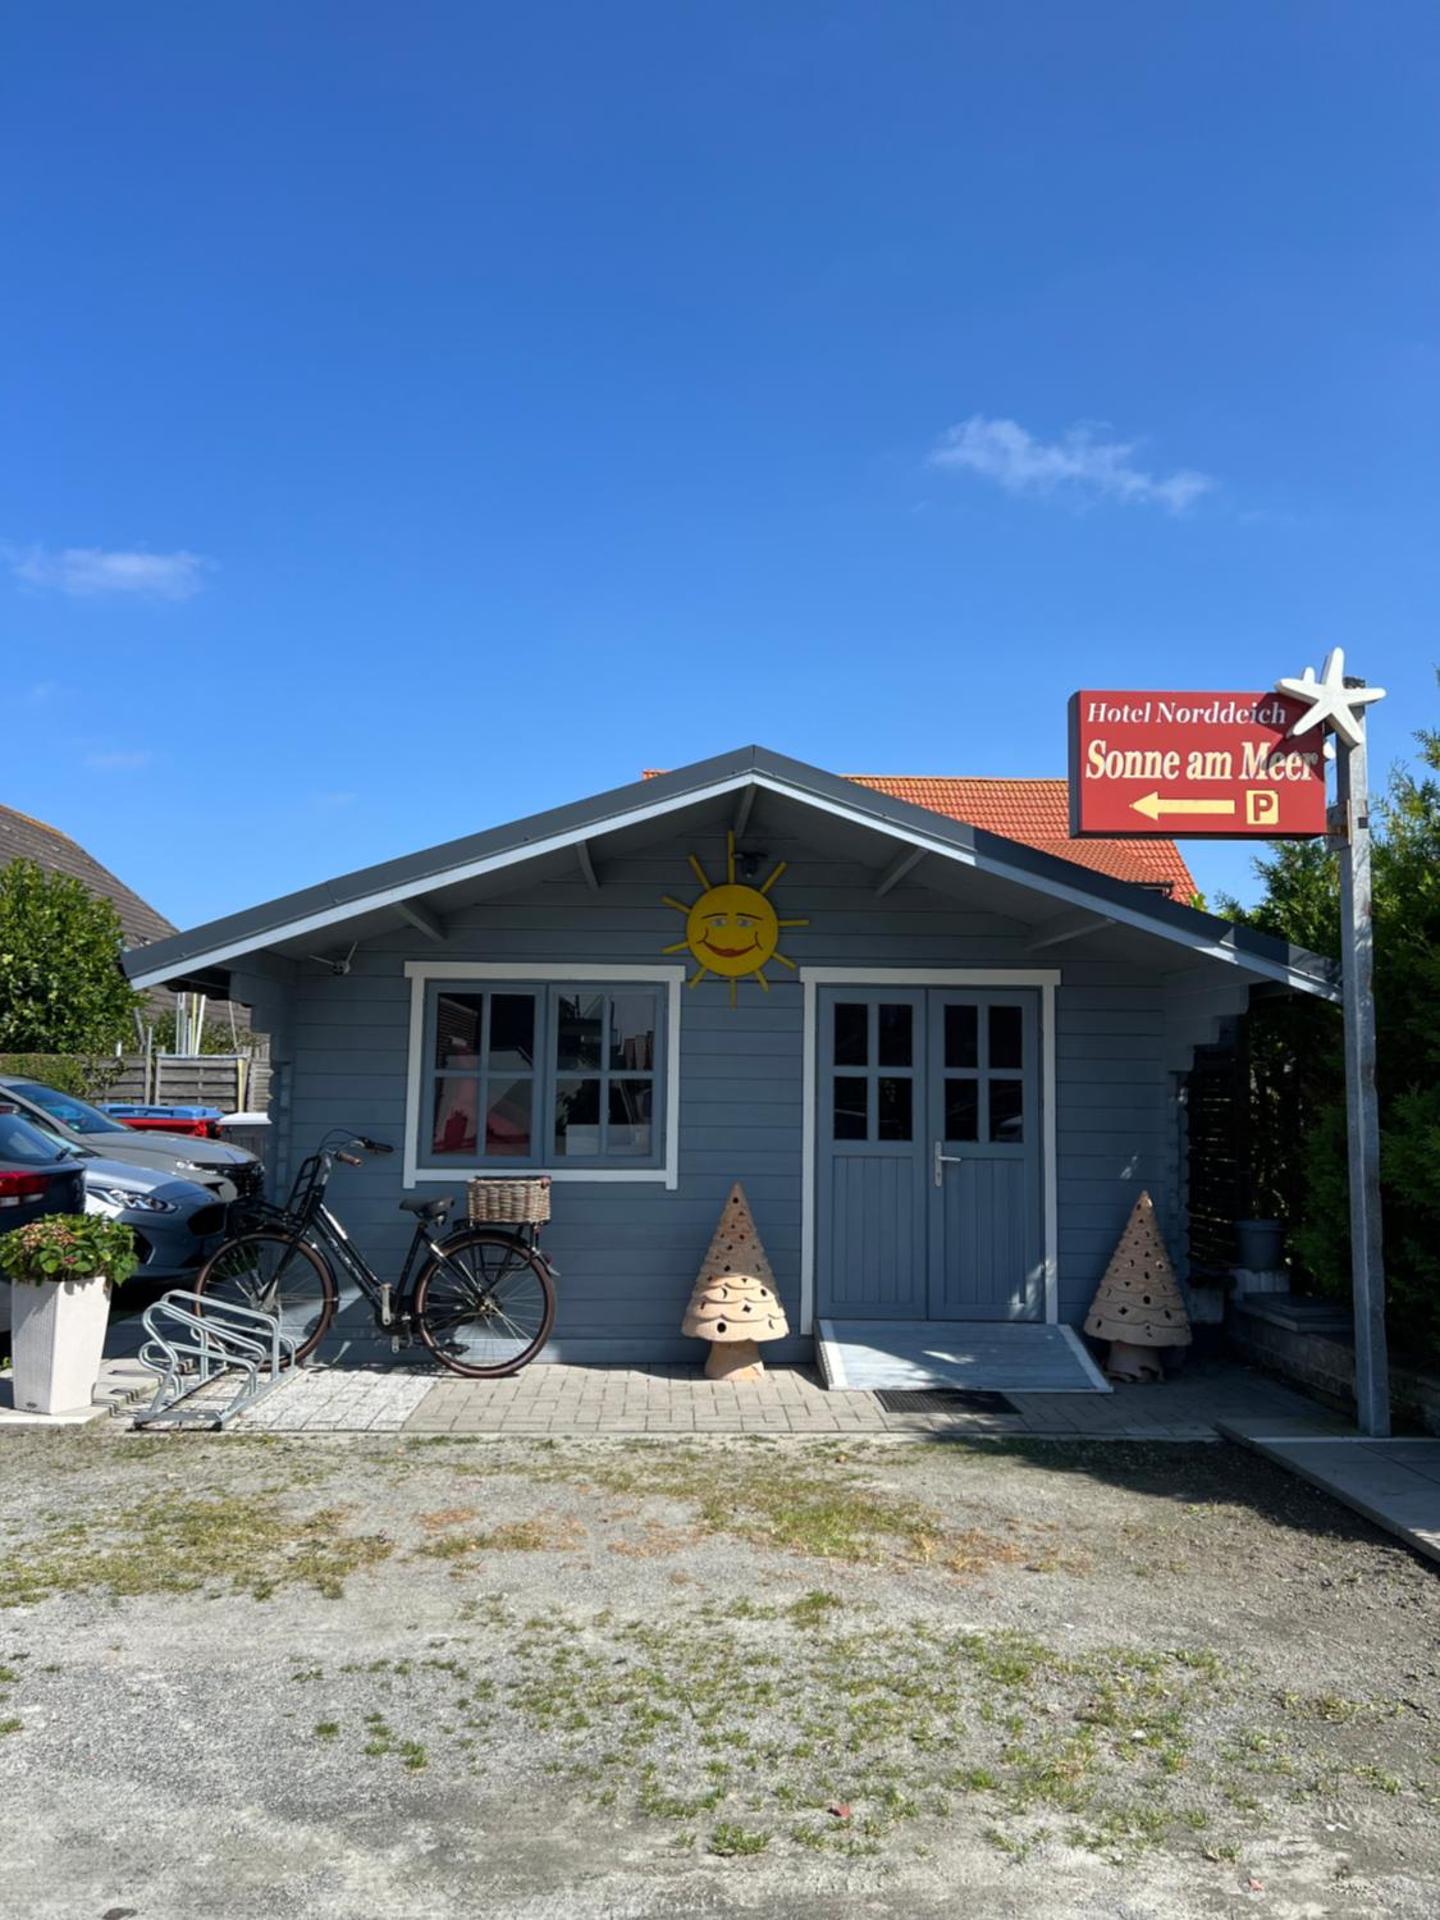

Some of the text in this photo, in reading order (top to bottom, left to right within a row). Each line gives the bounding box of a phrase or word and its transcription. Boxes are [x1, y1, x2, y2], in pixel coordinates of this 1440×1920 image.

[1087, 702, 1286, 724] Hotel Norddeich
[1086, 740, 1319, 782] Sonne am Meer
[1253, 794, 1273, 821] P
